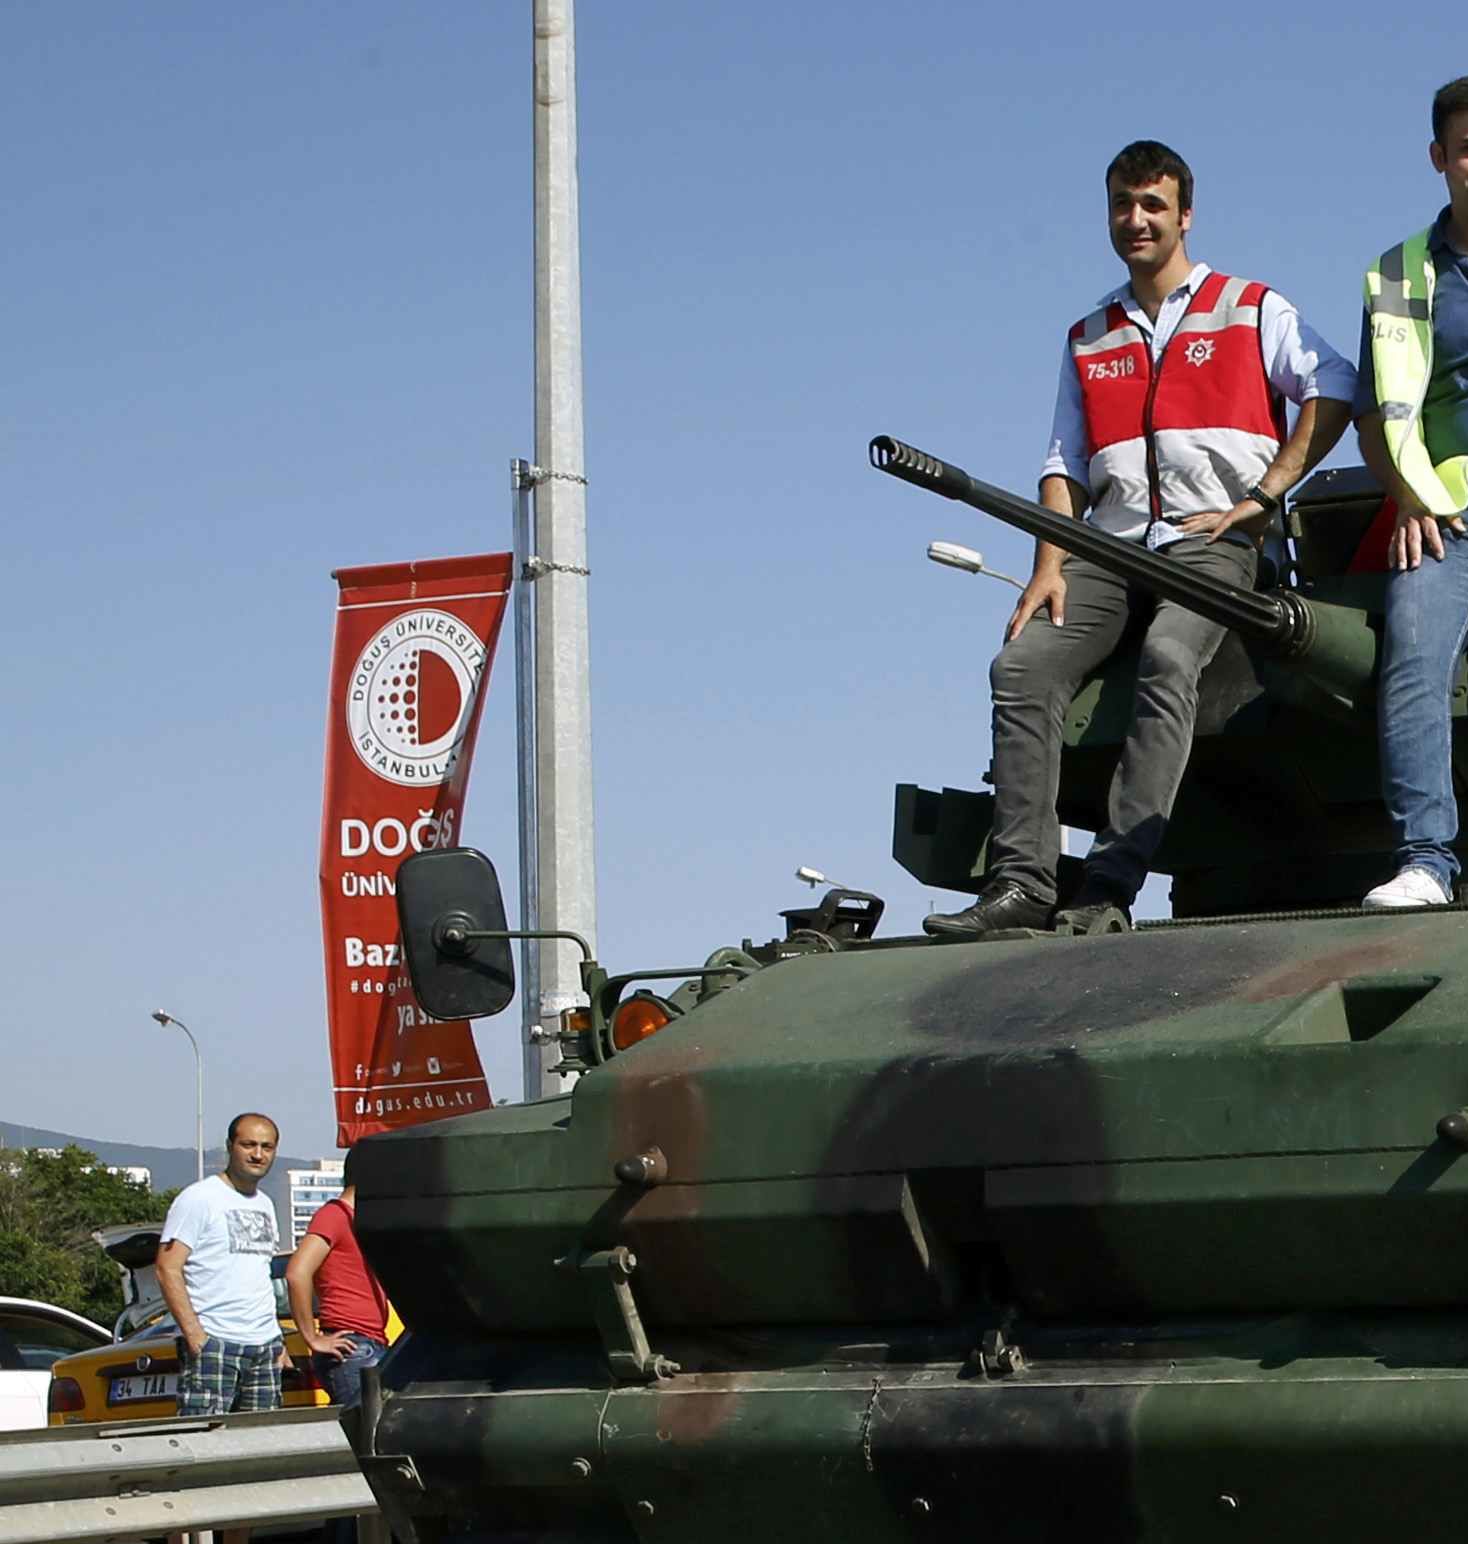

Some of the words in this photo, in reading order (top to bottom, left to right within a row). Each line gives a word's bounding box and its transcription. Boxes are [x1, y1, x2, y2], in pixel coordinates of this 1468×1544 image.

[1087, 355, 1135, 380] 75-318
[341, 808, 454, 857] DOĞŞ
[118, 1379, 132, 1397] 34
